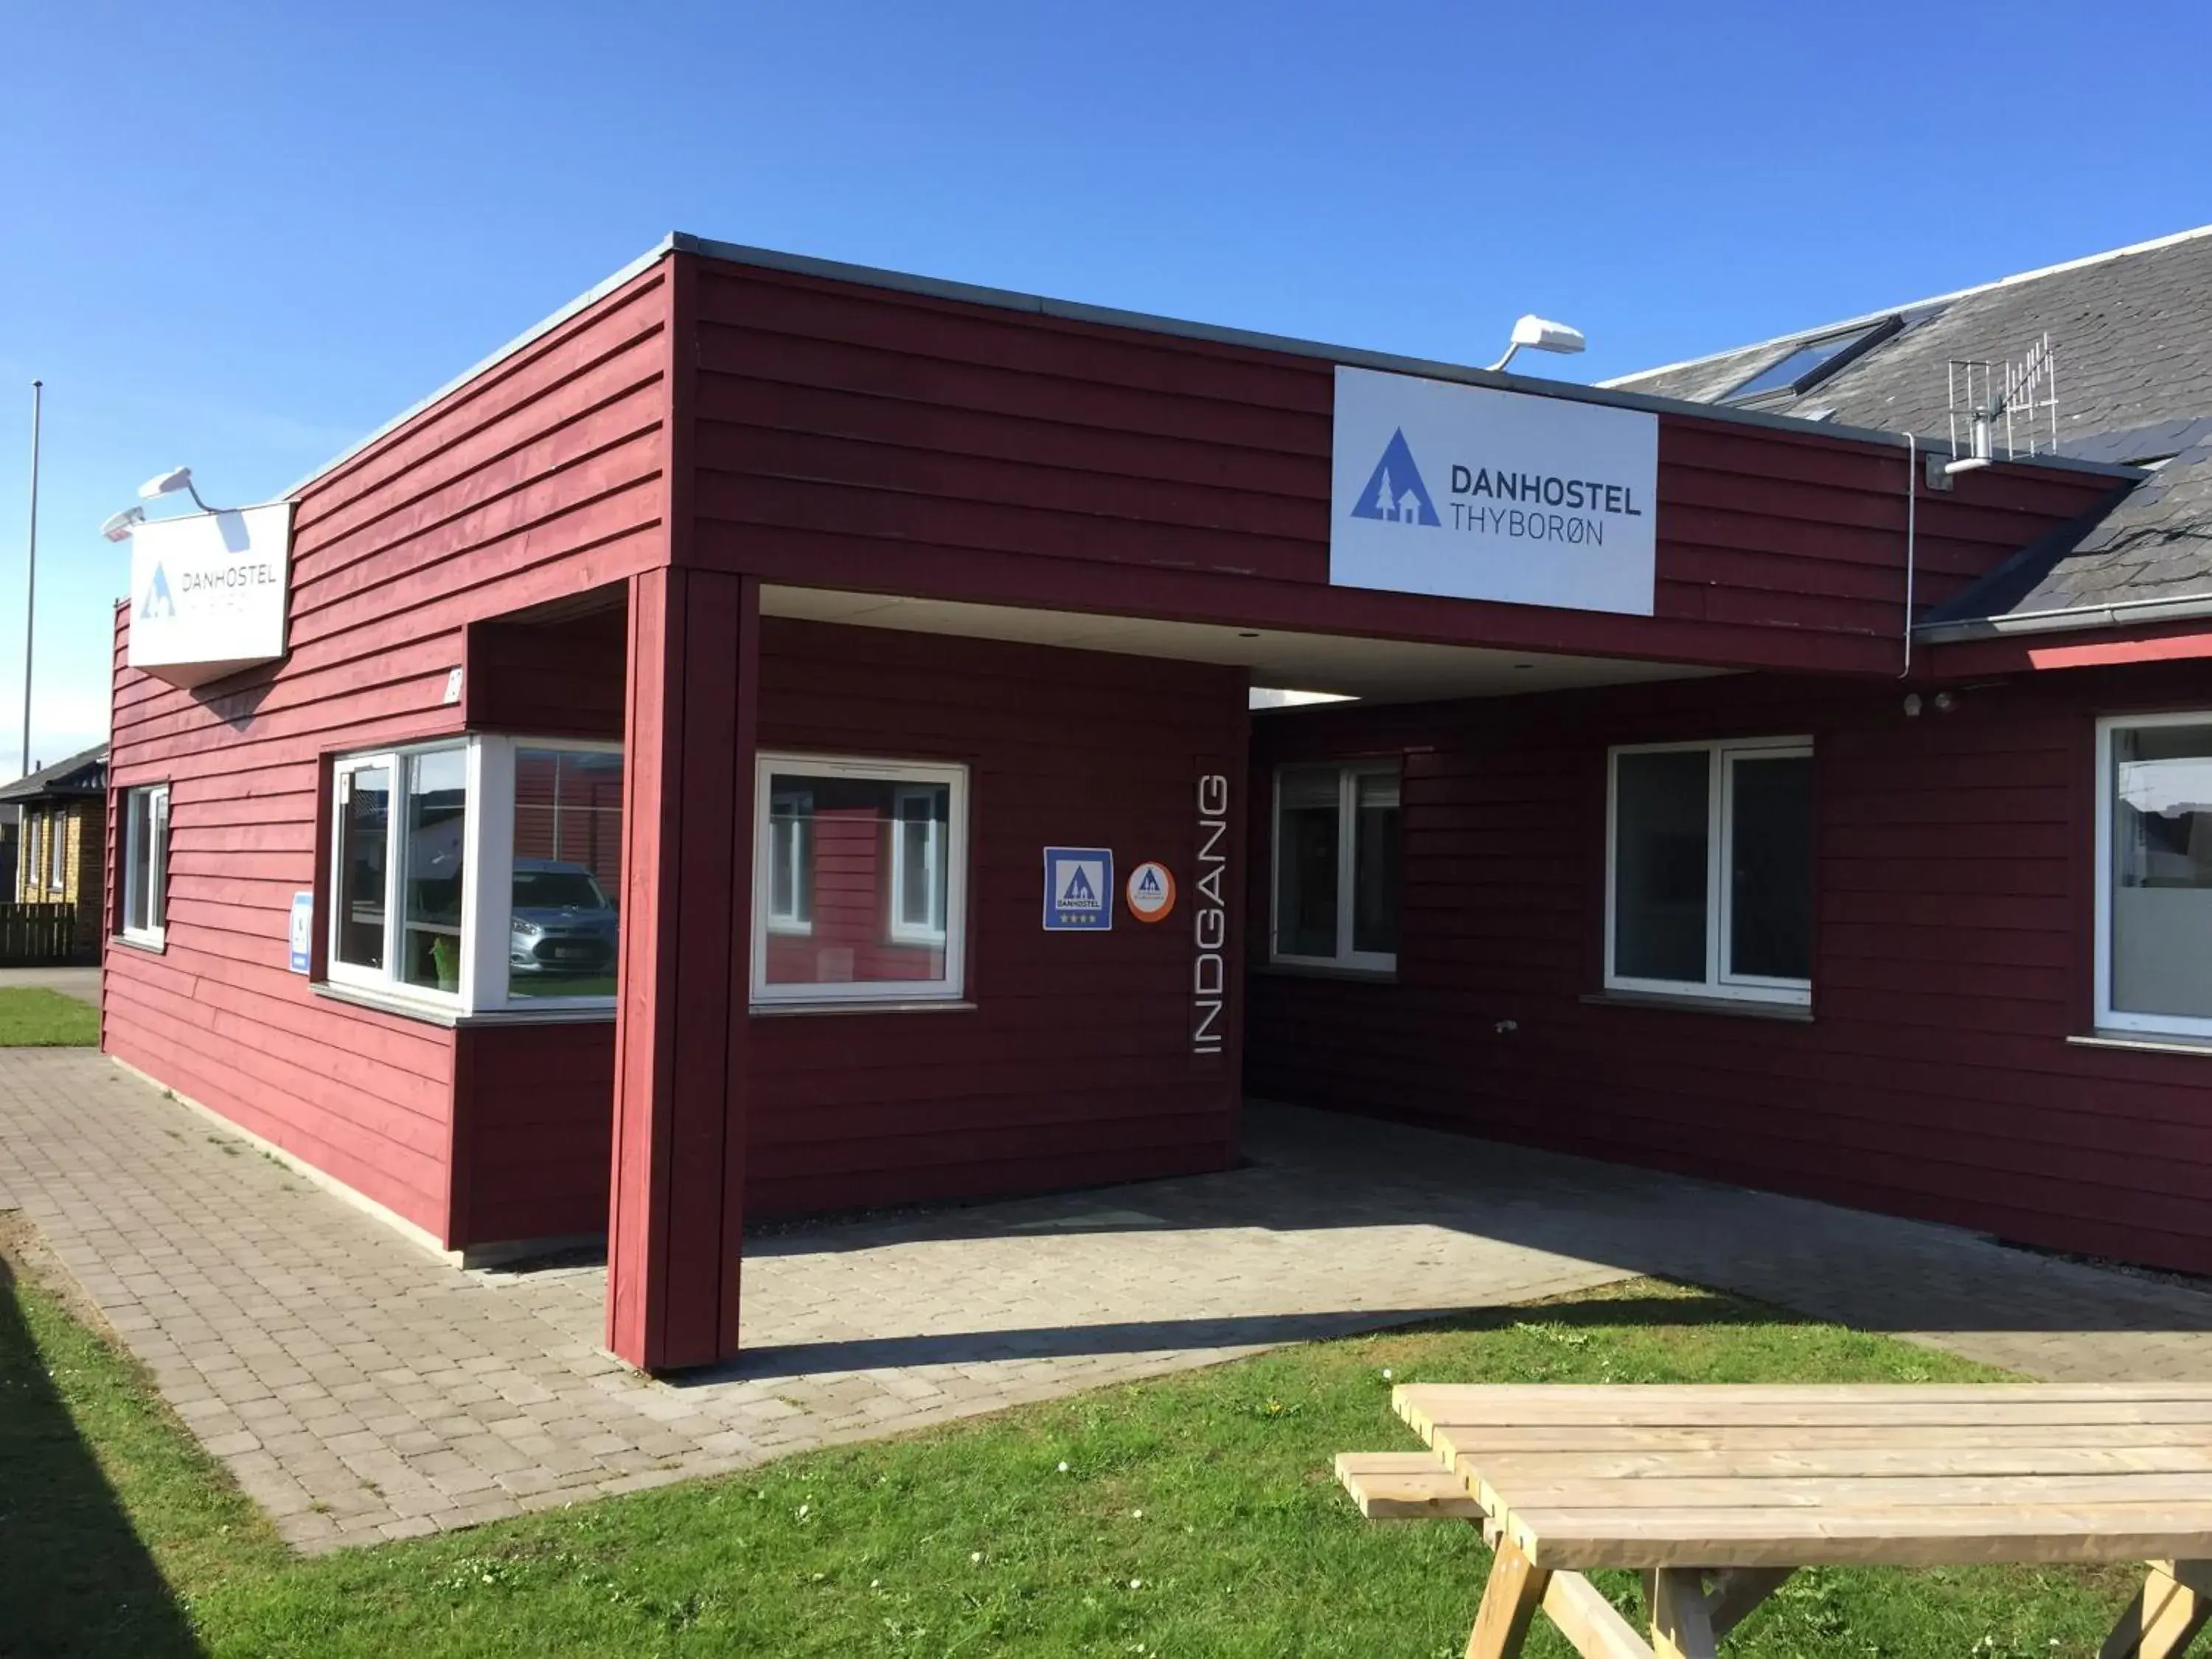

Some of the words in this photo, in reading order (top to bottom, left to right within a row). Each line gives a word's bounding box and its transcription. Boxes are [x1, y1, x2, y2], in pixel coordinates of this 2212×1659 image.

[1452, 465, 1641, 515] DANHOSTEL
[1450, 503, 1603, 546] THYBORØN
[183, 564, 276, 592] DANHOSTEL
[1194, 774, 1228, 1054] INDGANG
